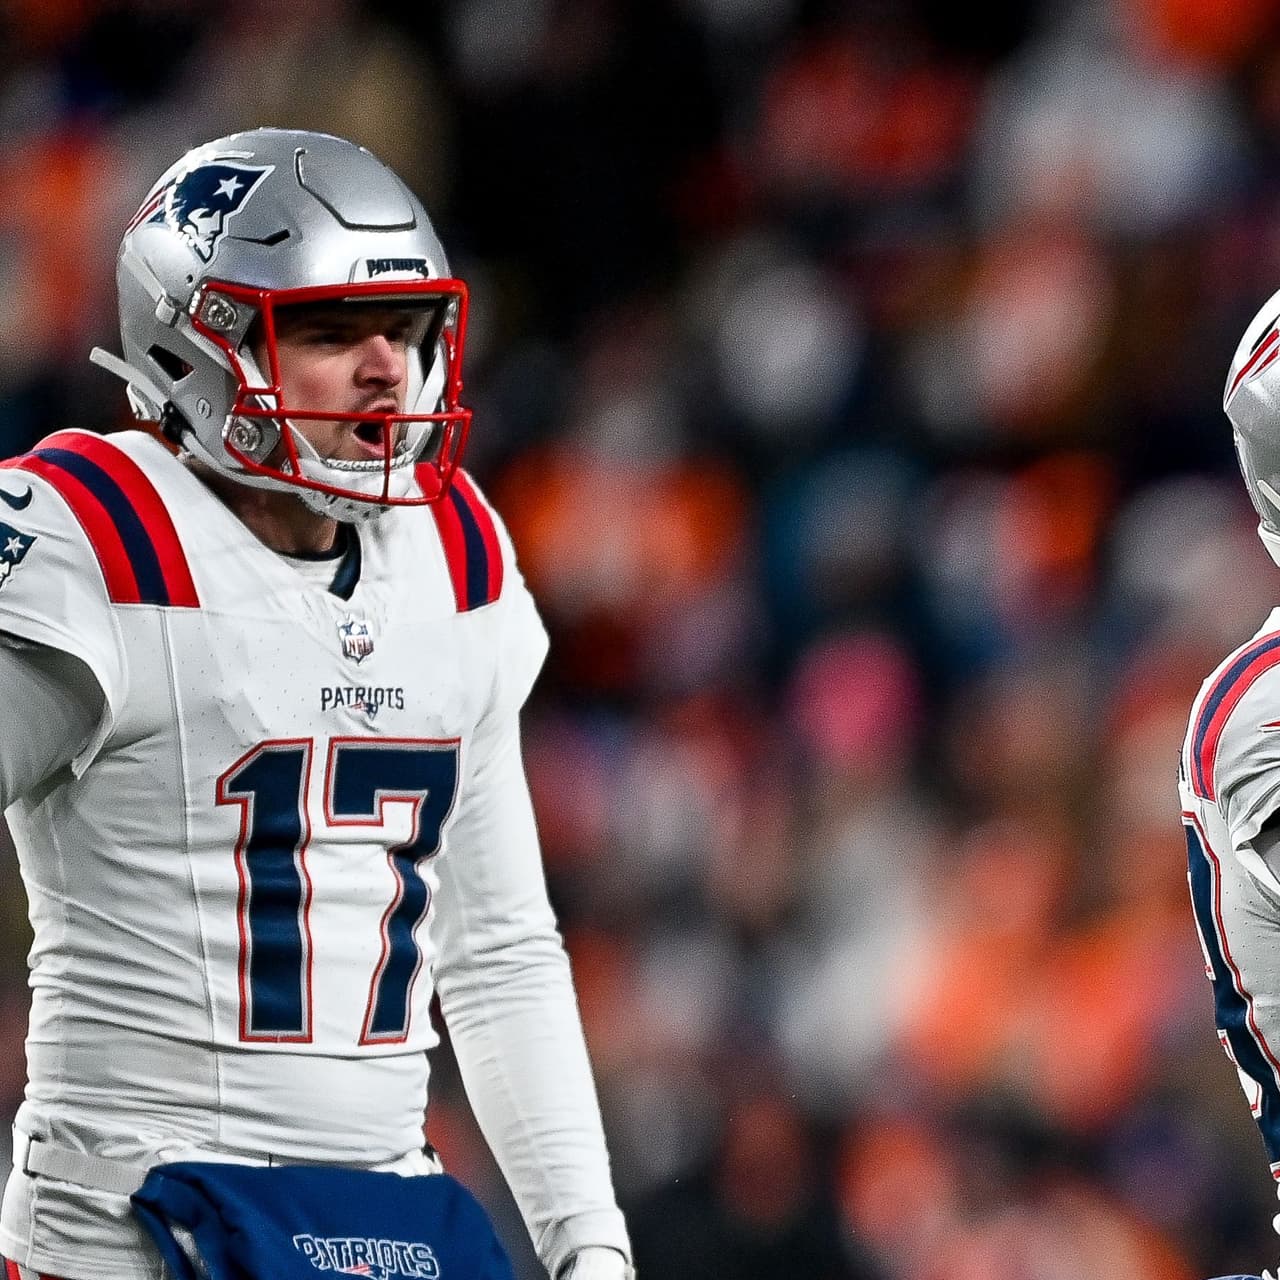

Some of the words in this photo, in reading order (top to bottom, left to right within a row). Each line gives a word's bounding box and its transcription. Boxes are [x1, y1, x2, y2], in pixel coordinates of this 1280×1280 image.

[321, 687, 404, 711] PATRIOTS
[215, 737, 462, 1047] 17
[293, 1233, 441, 1280] PATRIOTS
